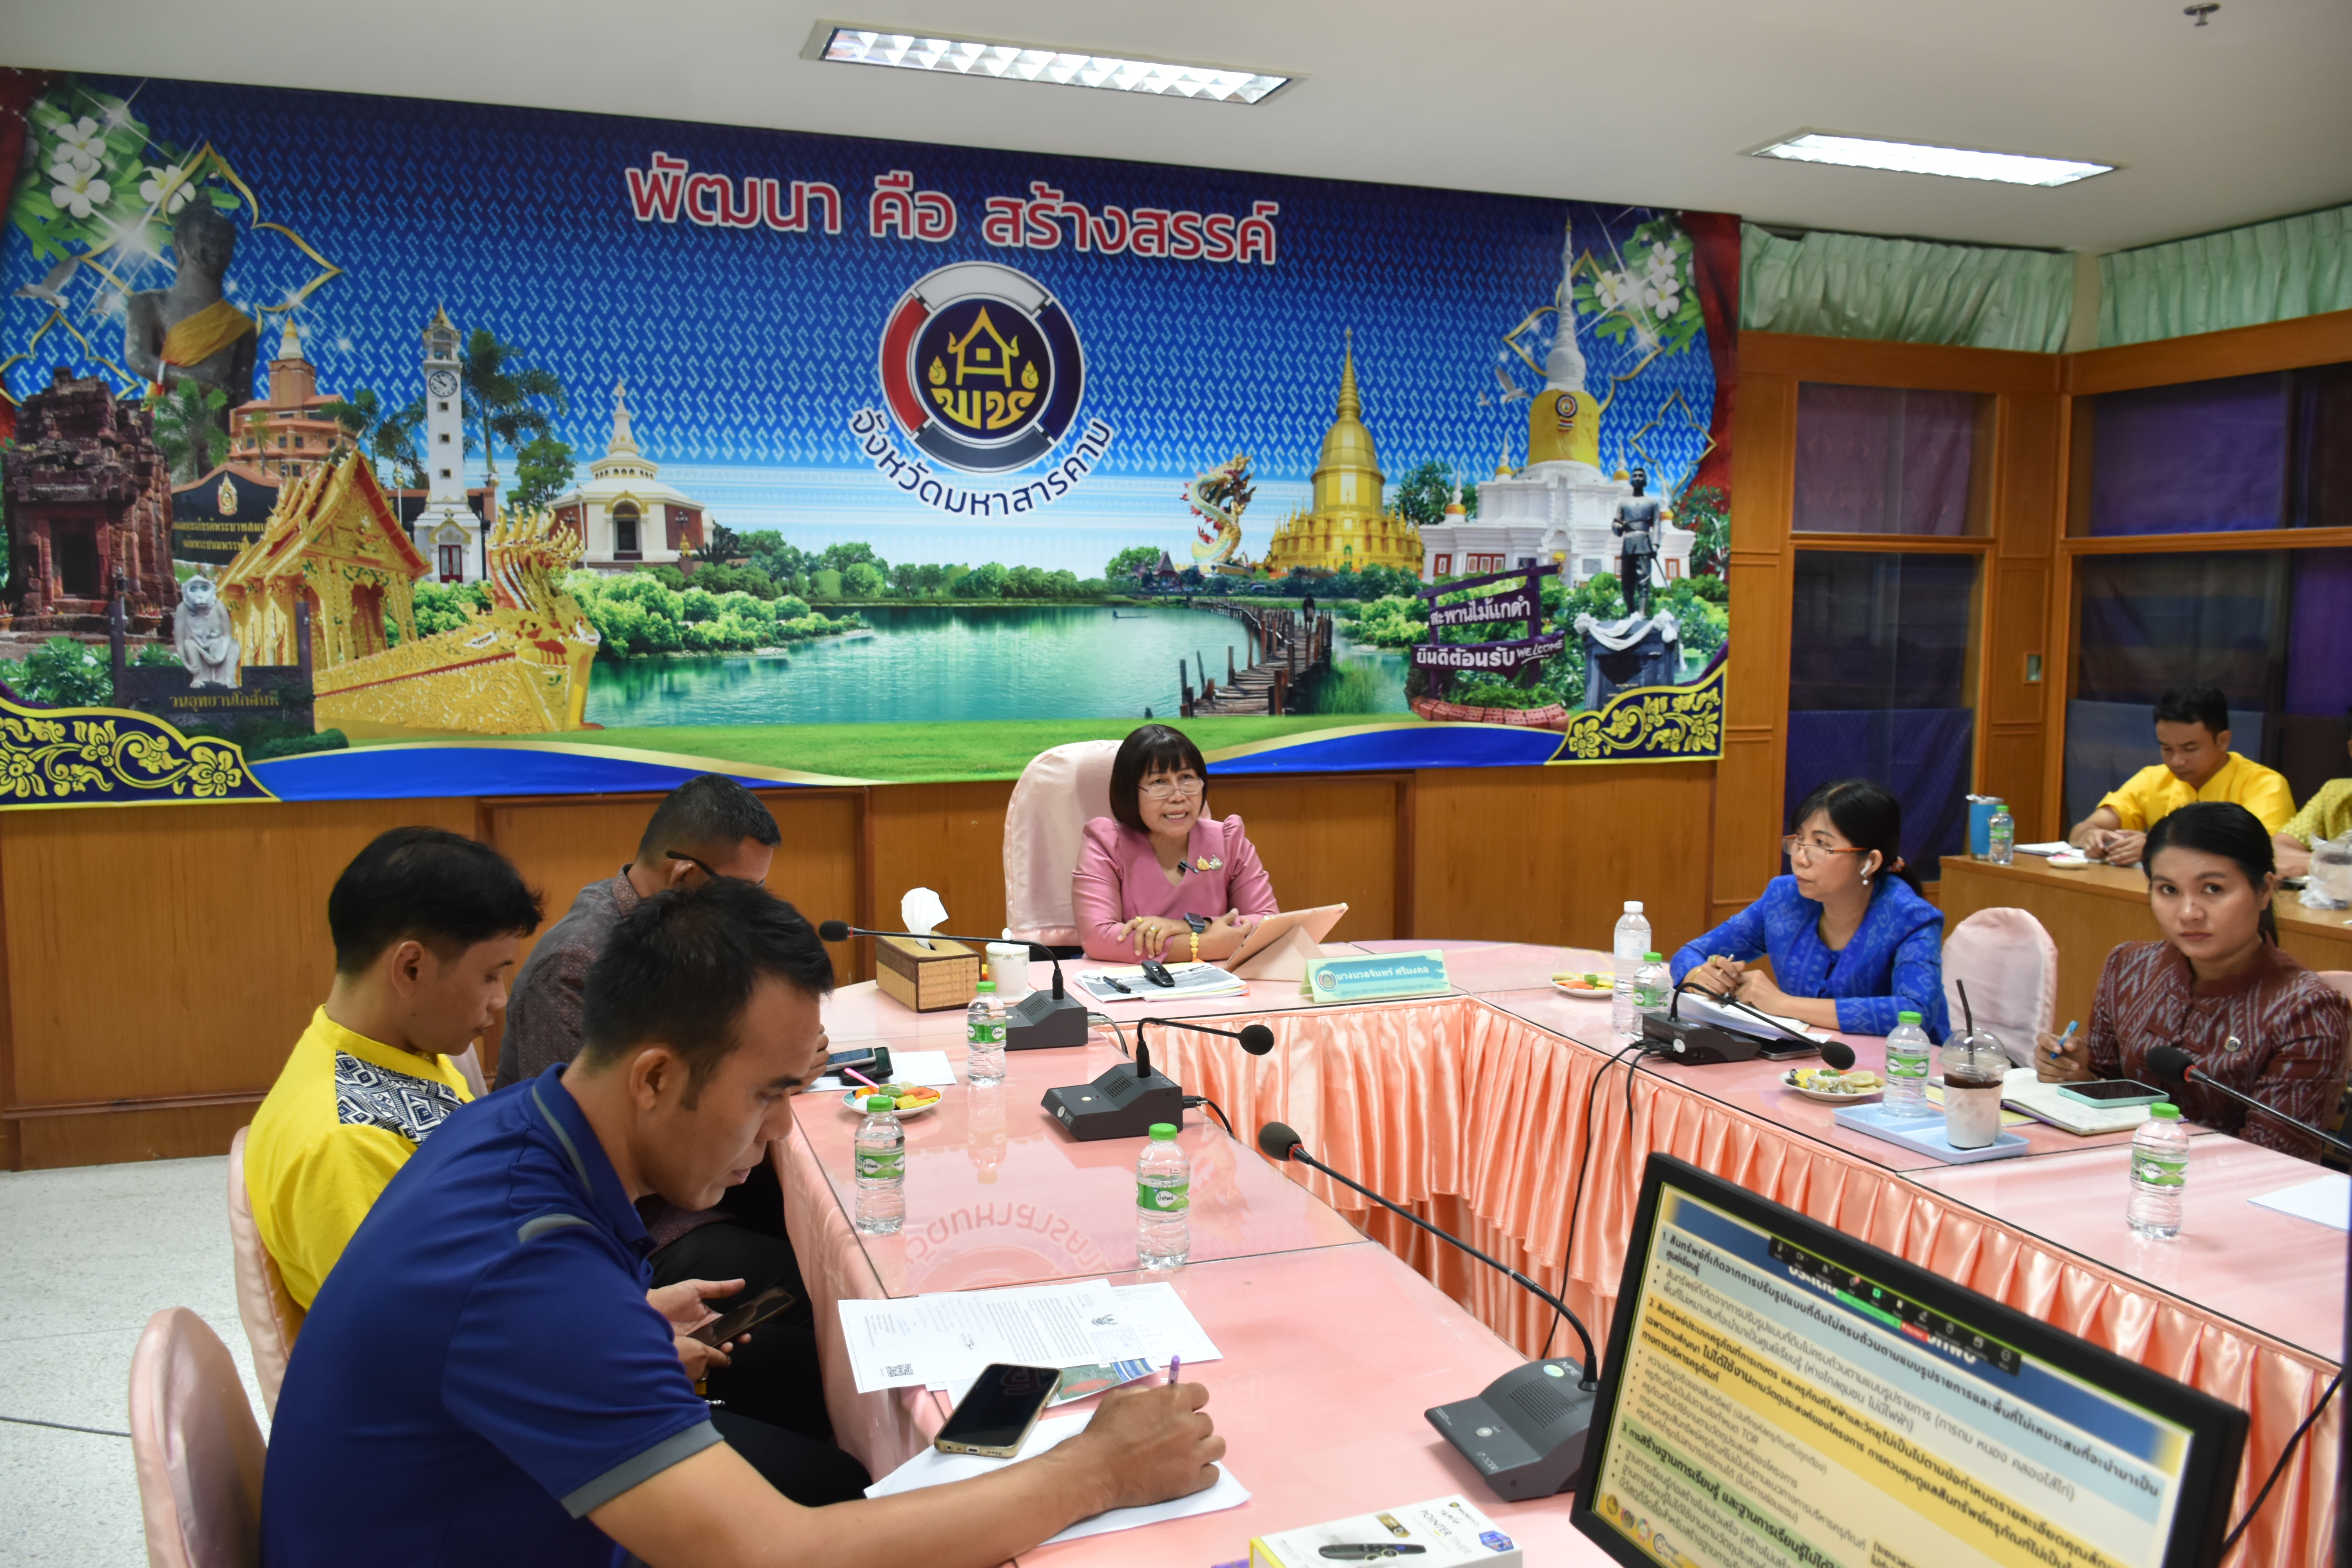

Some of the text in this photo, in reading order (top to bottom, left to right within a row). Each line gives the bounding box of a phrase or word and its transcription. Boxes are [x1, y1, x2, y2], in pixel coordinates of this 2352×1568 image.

[626, 152, 1278, 262] พัฒนา คือ สร้างสรรค์
[851, 408, 1112, 517] จังหวัดมหาสารคาม
[1430, 595, 1531, 626] สะพานไม้แกดำ
[1416, 647, 1515, 667] ยินดีต้อนรับ
[1516, 639, 1564, 658] WELCOME
[1742, 1428, 1759, 1446] TOR
[1419, 1509, 1452, 1537] POINTER
